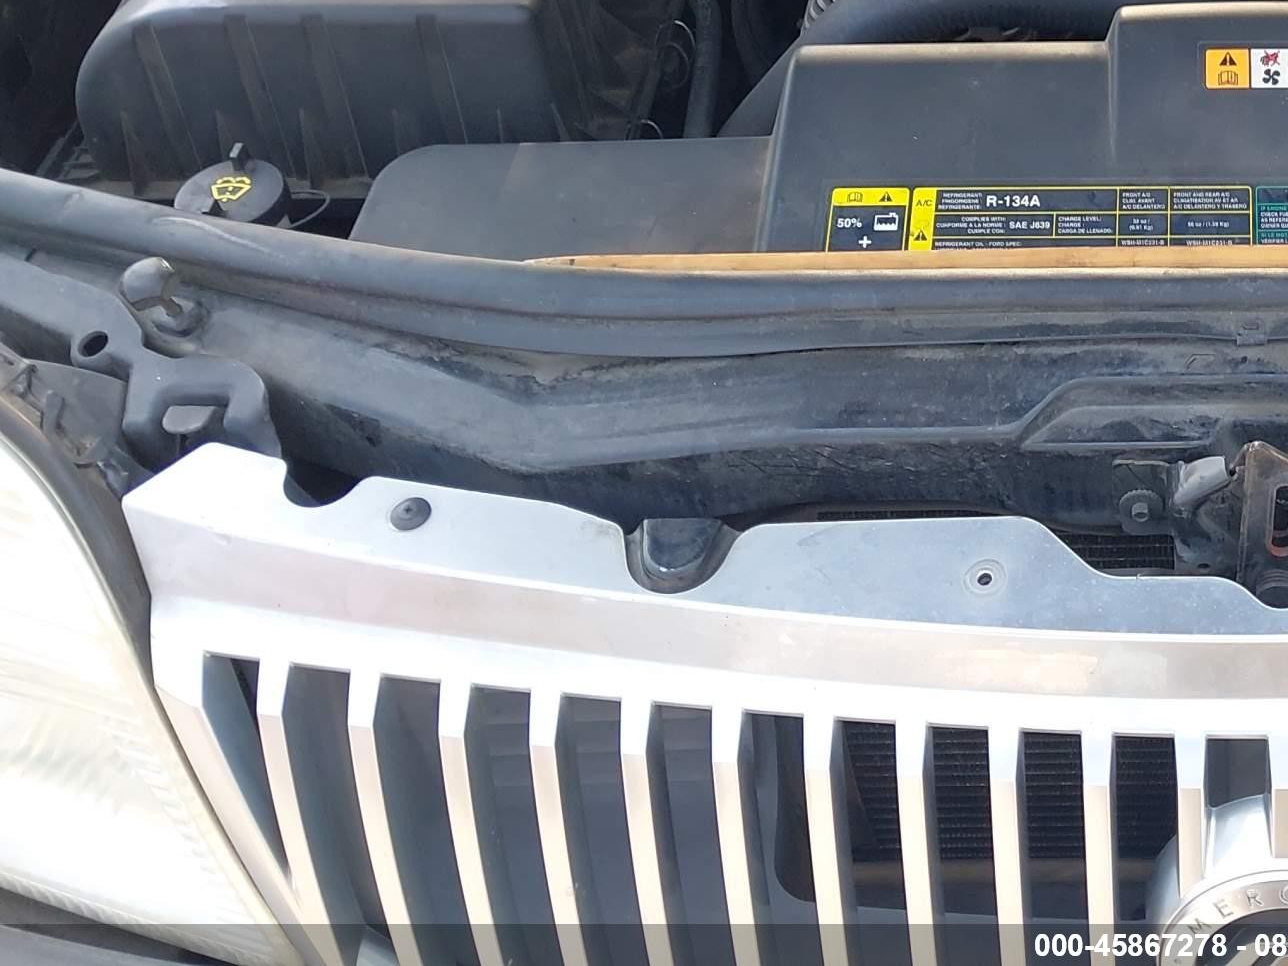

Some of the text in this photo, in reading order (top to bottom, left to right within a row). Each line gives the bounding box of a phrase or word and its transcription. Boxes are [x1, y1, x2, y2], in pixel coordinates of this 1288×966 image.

[915, 199, 933, 207] A/C
[986, 194, 1041, 208] R-134A
[836, 217, 863, 229] 50%
[1008, 220, 1028, 229] SAE
